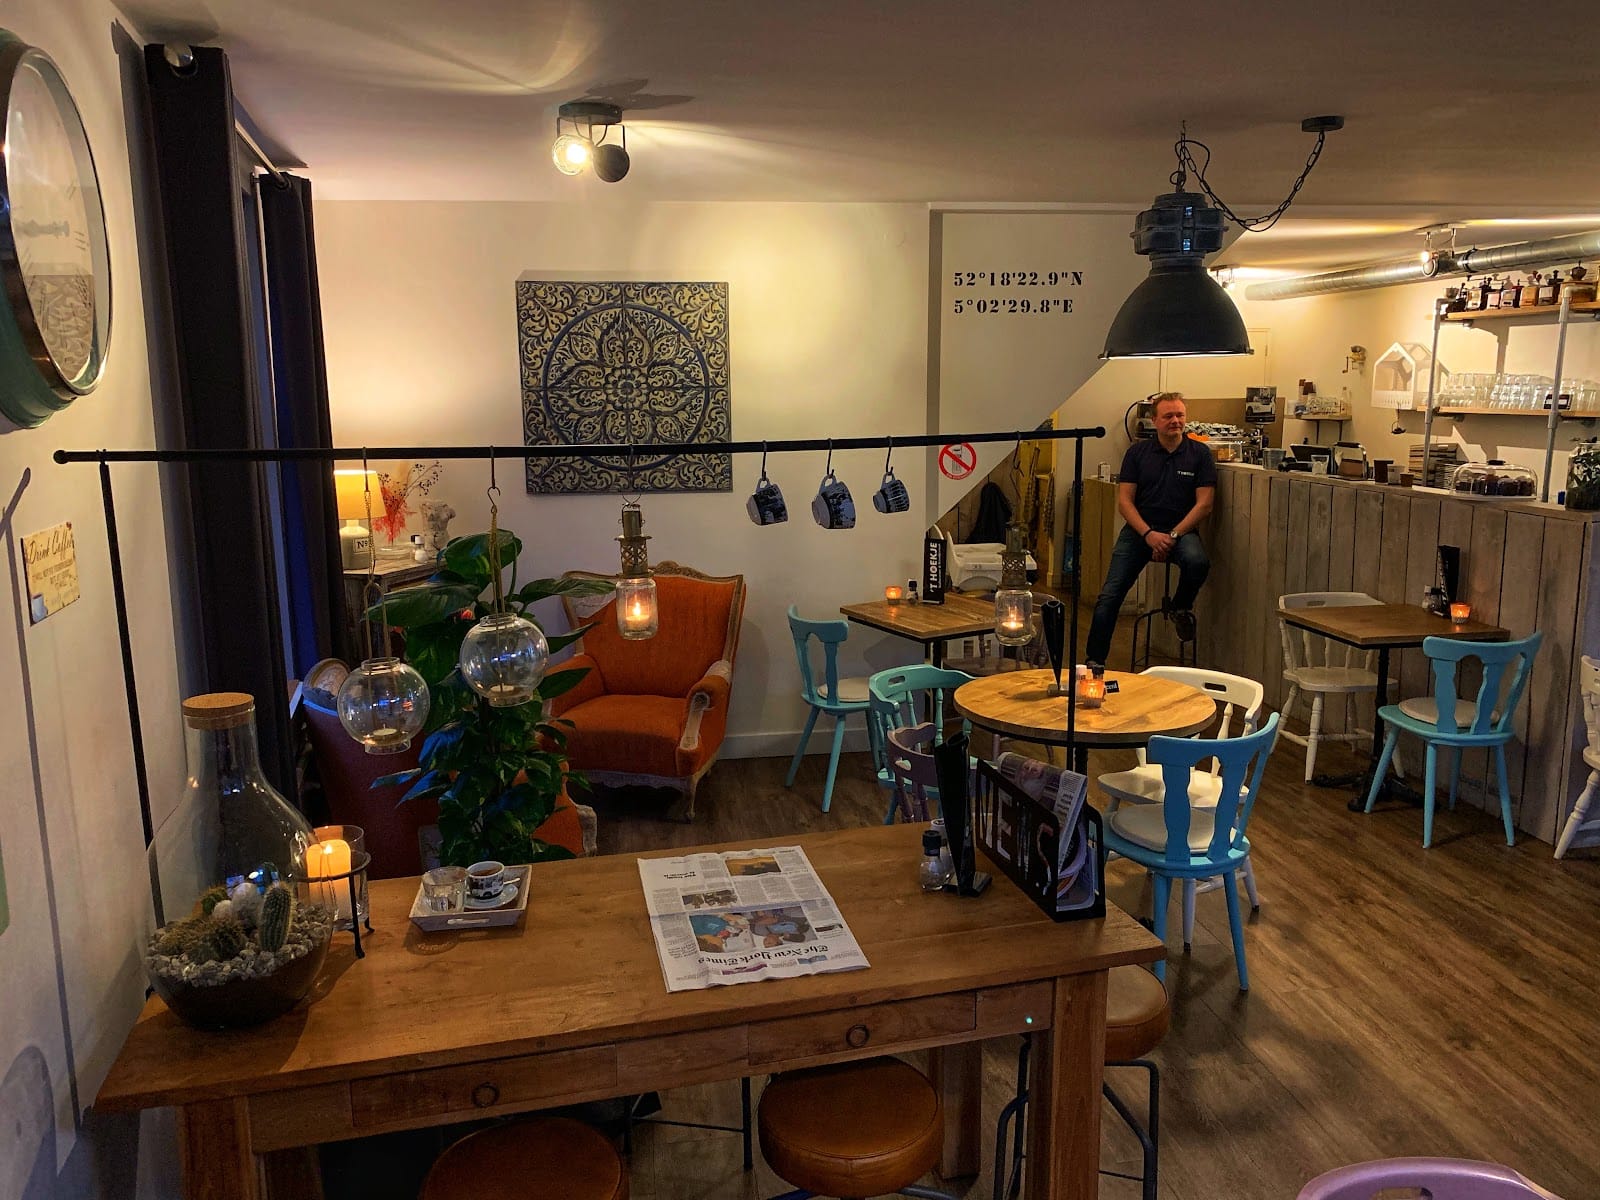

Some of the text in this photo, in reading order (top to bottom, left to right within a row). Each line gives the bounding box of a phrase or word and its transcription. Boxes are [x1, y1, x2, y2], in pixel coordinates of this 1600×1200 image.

[954, 271, 1083, 286] 52°18'22.9"N
[954, 299, 1073, 314] 5°02'29.8"E
[27, 536, 50, 564] Drink
[697, 955, 739, 966] Times
[740, 951, 772, 964] York
